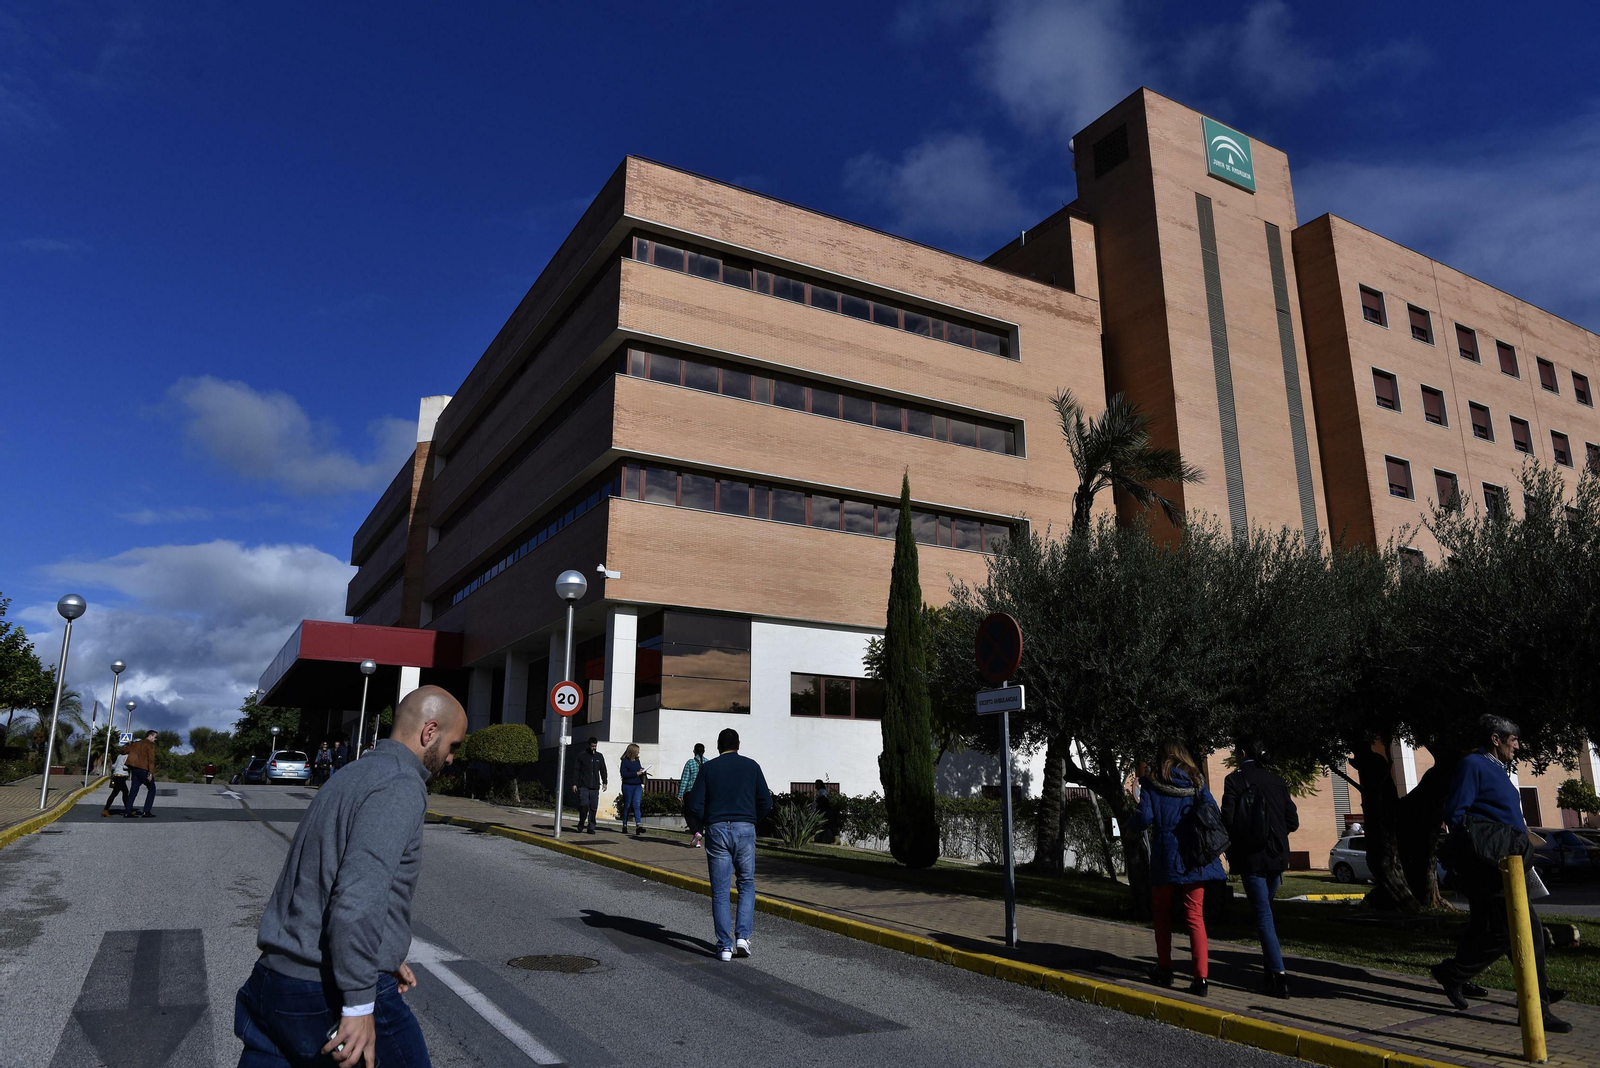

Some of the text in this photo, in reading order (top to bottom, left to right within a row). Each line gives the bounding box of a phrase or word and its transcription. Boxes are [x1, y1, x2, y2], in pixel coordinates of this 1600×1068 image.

[1213, 159, 1225, 169] JUNTA
[1225, 164, 1231, 172] DE
[557, 692, 577, 705] 20
[994, 696, 1018, 704] AMBULANCIAS
